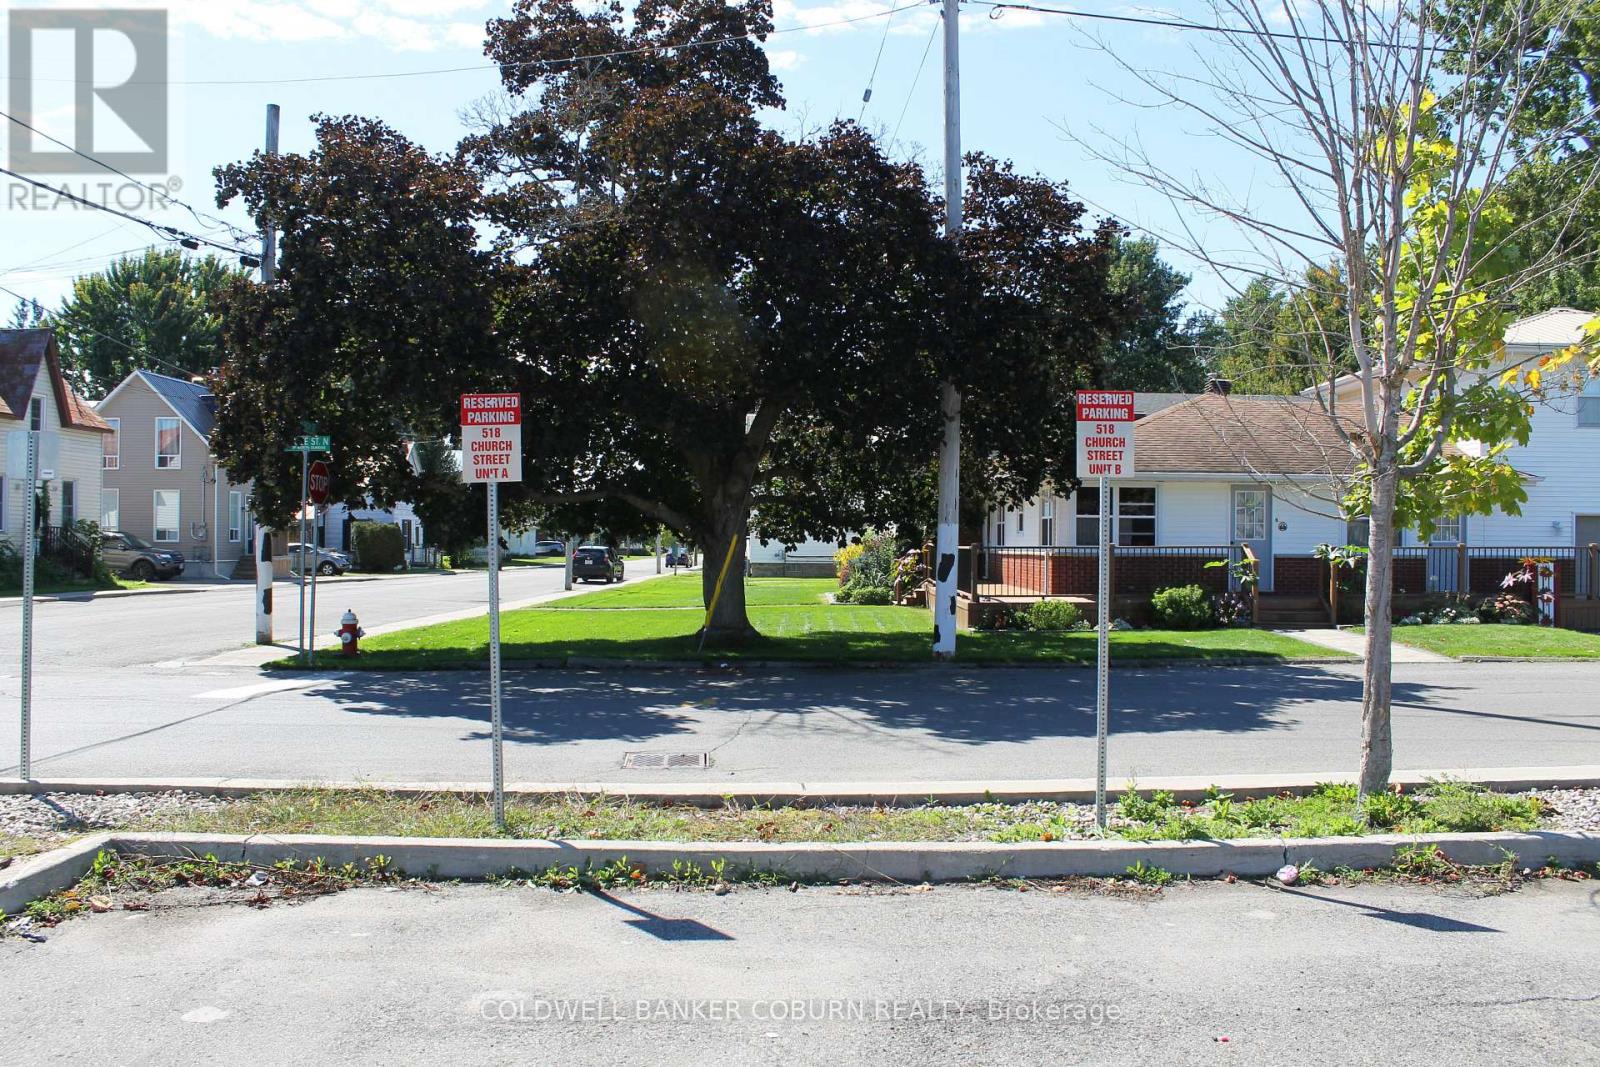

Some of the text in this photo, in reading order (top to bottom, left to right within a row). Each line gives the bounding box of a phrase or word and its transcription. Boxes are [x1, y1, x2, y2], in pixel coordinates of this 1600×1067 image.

[463, 396, 519, 409] RESERVED
[1078, 393, 1133, 405] RESERVED
[467, 411, 515, 423] PARKING
[1082, 407, 1129, 419] PARKING
[482, 427, 501, 438] 518
[1096, 424, 1115, 434] 518
[322, 437, 329, 446] N
[471, 441, 512, 452] CHURCH
[1085, 437, 1126, 448] CHURCH
[473, 454, 511, 465] STREET
[1087, 450, 1124, 461] STREET
[501, 467, 509, 479] A
[1089, 464, 1122, 475] UNIT B
[310, 474, 328, 492] STOP
